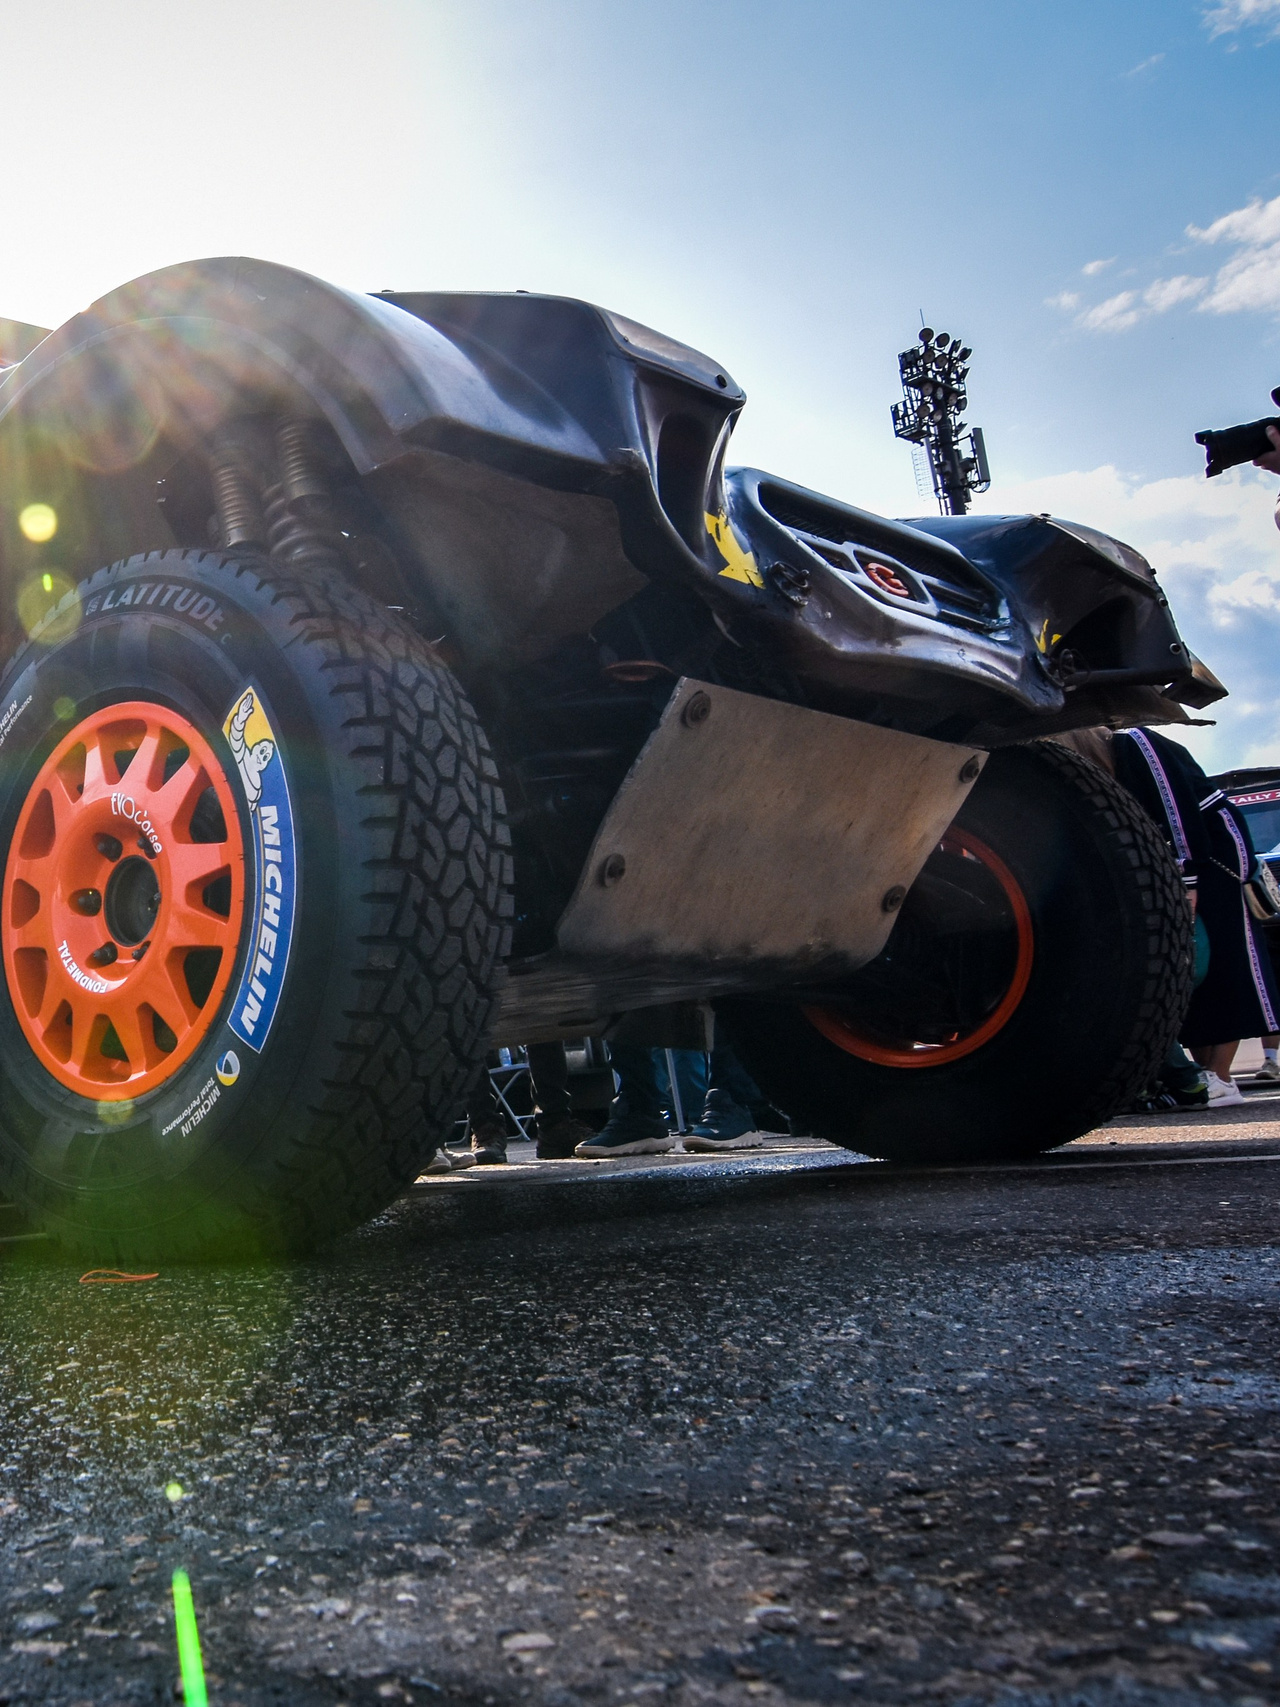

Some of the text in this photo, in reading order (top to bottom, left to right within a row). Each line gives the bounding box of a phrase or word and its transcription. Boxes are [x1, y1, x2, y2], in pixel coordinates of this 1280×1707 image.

[101, 583, 225, 631] LATITUDE
[3, 695, 33, 736] Performance
[240, 805, 282, 1036] MICHELIN
[57, 940, 109, 994] FONDMETAL
[161, 1077, 215, 1136] Total Performance
[180, 1085, 221, 1137] MICHELIN
